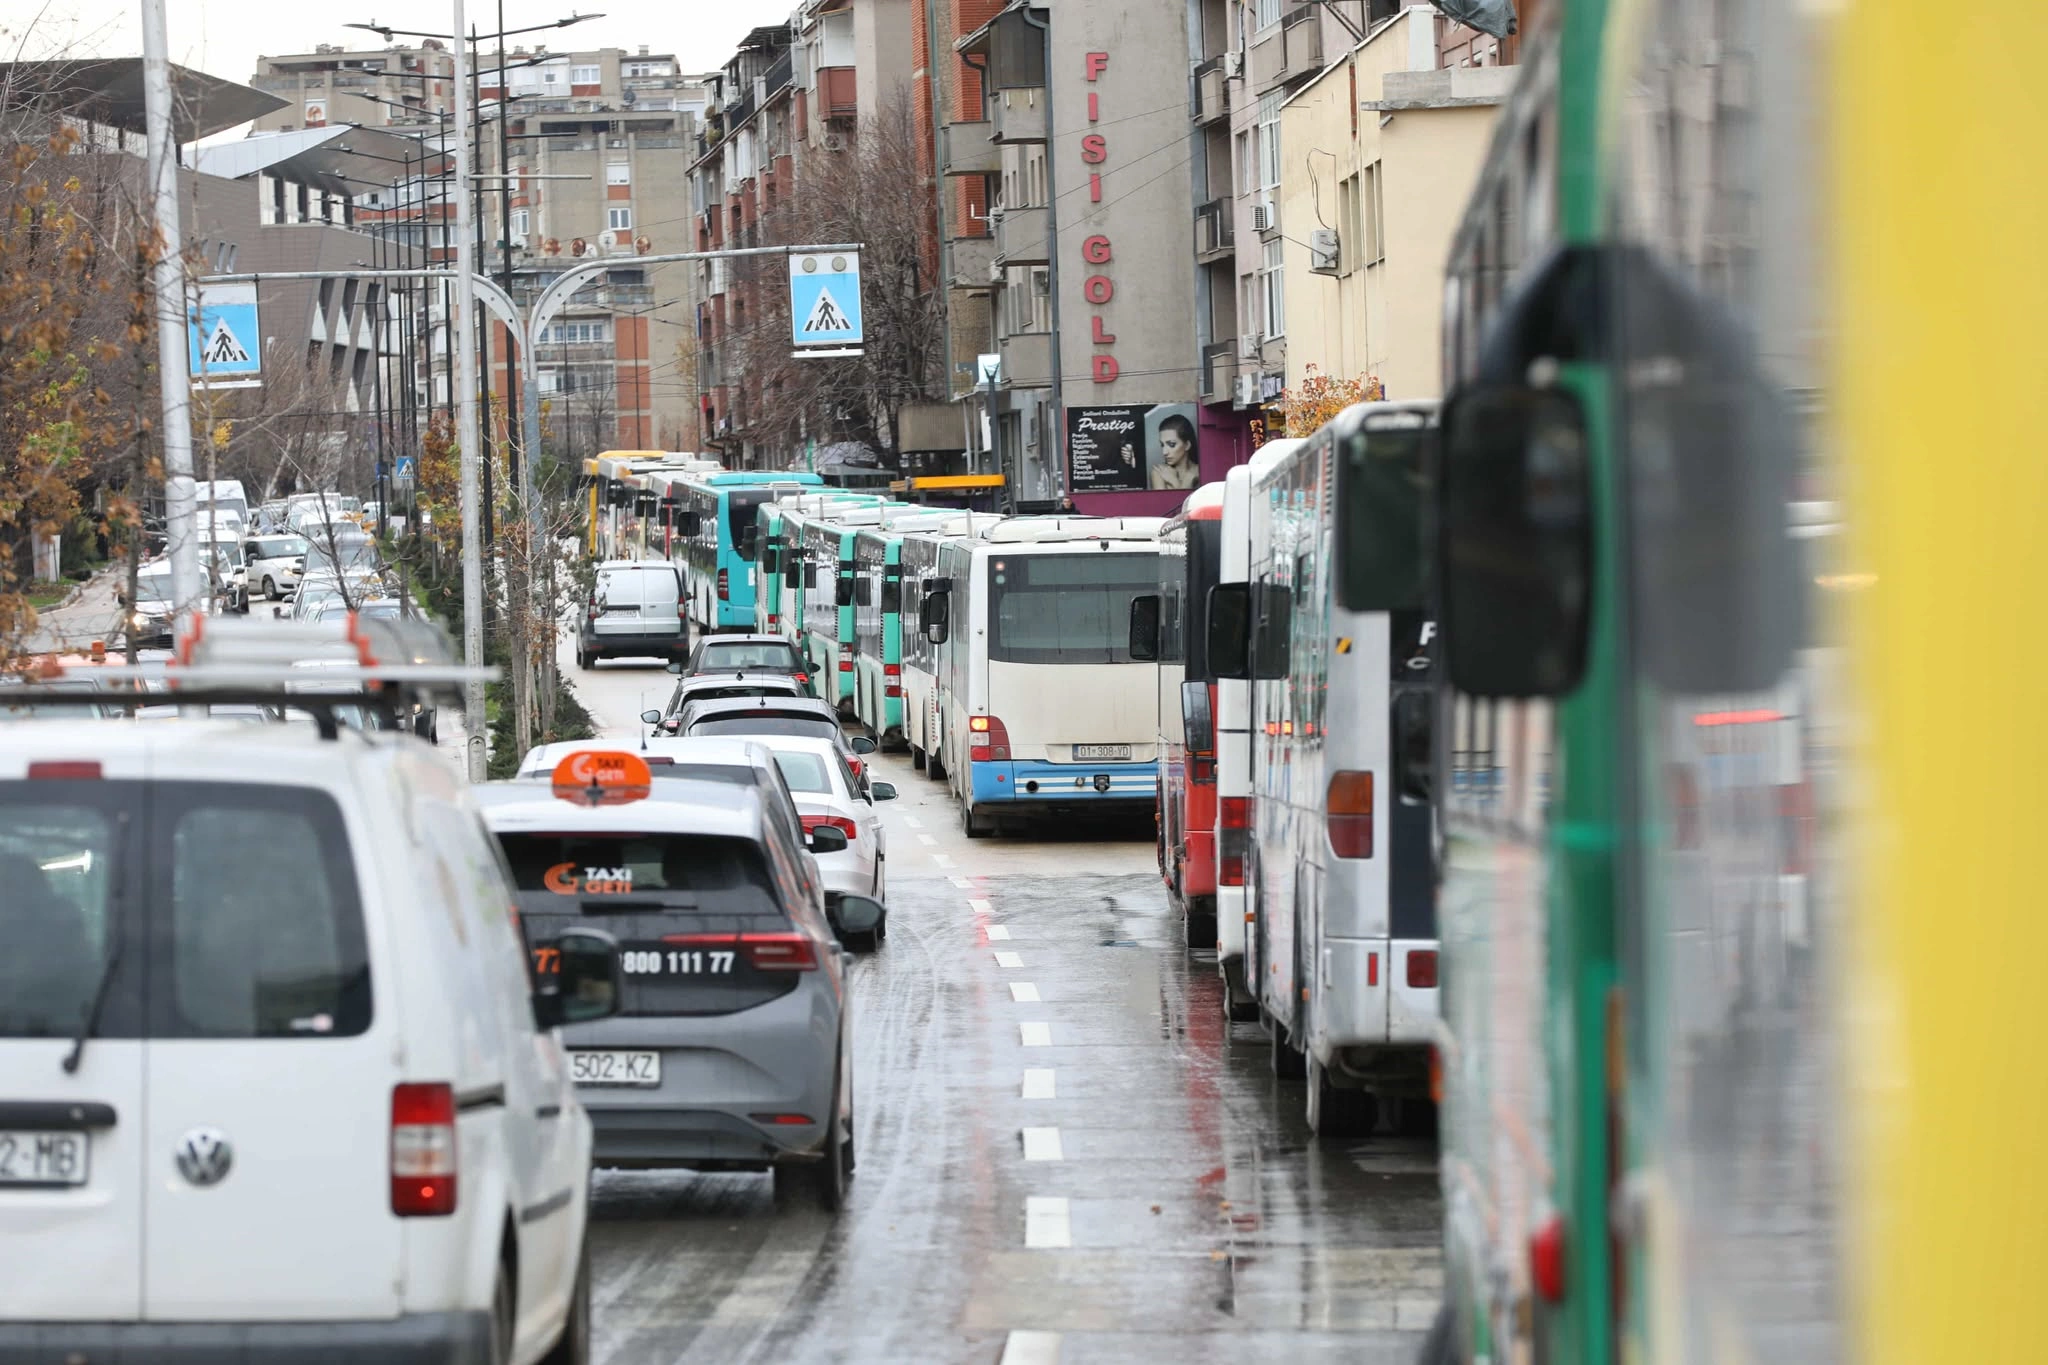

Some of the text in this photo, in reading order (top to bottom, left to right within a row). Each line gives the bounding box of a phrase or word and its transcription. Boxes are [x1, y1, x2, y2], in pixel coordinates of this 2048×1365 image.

[1081, 51, 1119, 384] FISI GOLD
[1078, 417, 1135, 434] Prestige
[598, 758, 625, 769] TAXI
[586, 867, 633, 881] TAXI
[585, 880, 633, 894] GETI
[667, 951, 702, 973] 111
[709, 951, 736, 973] 77
